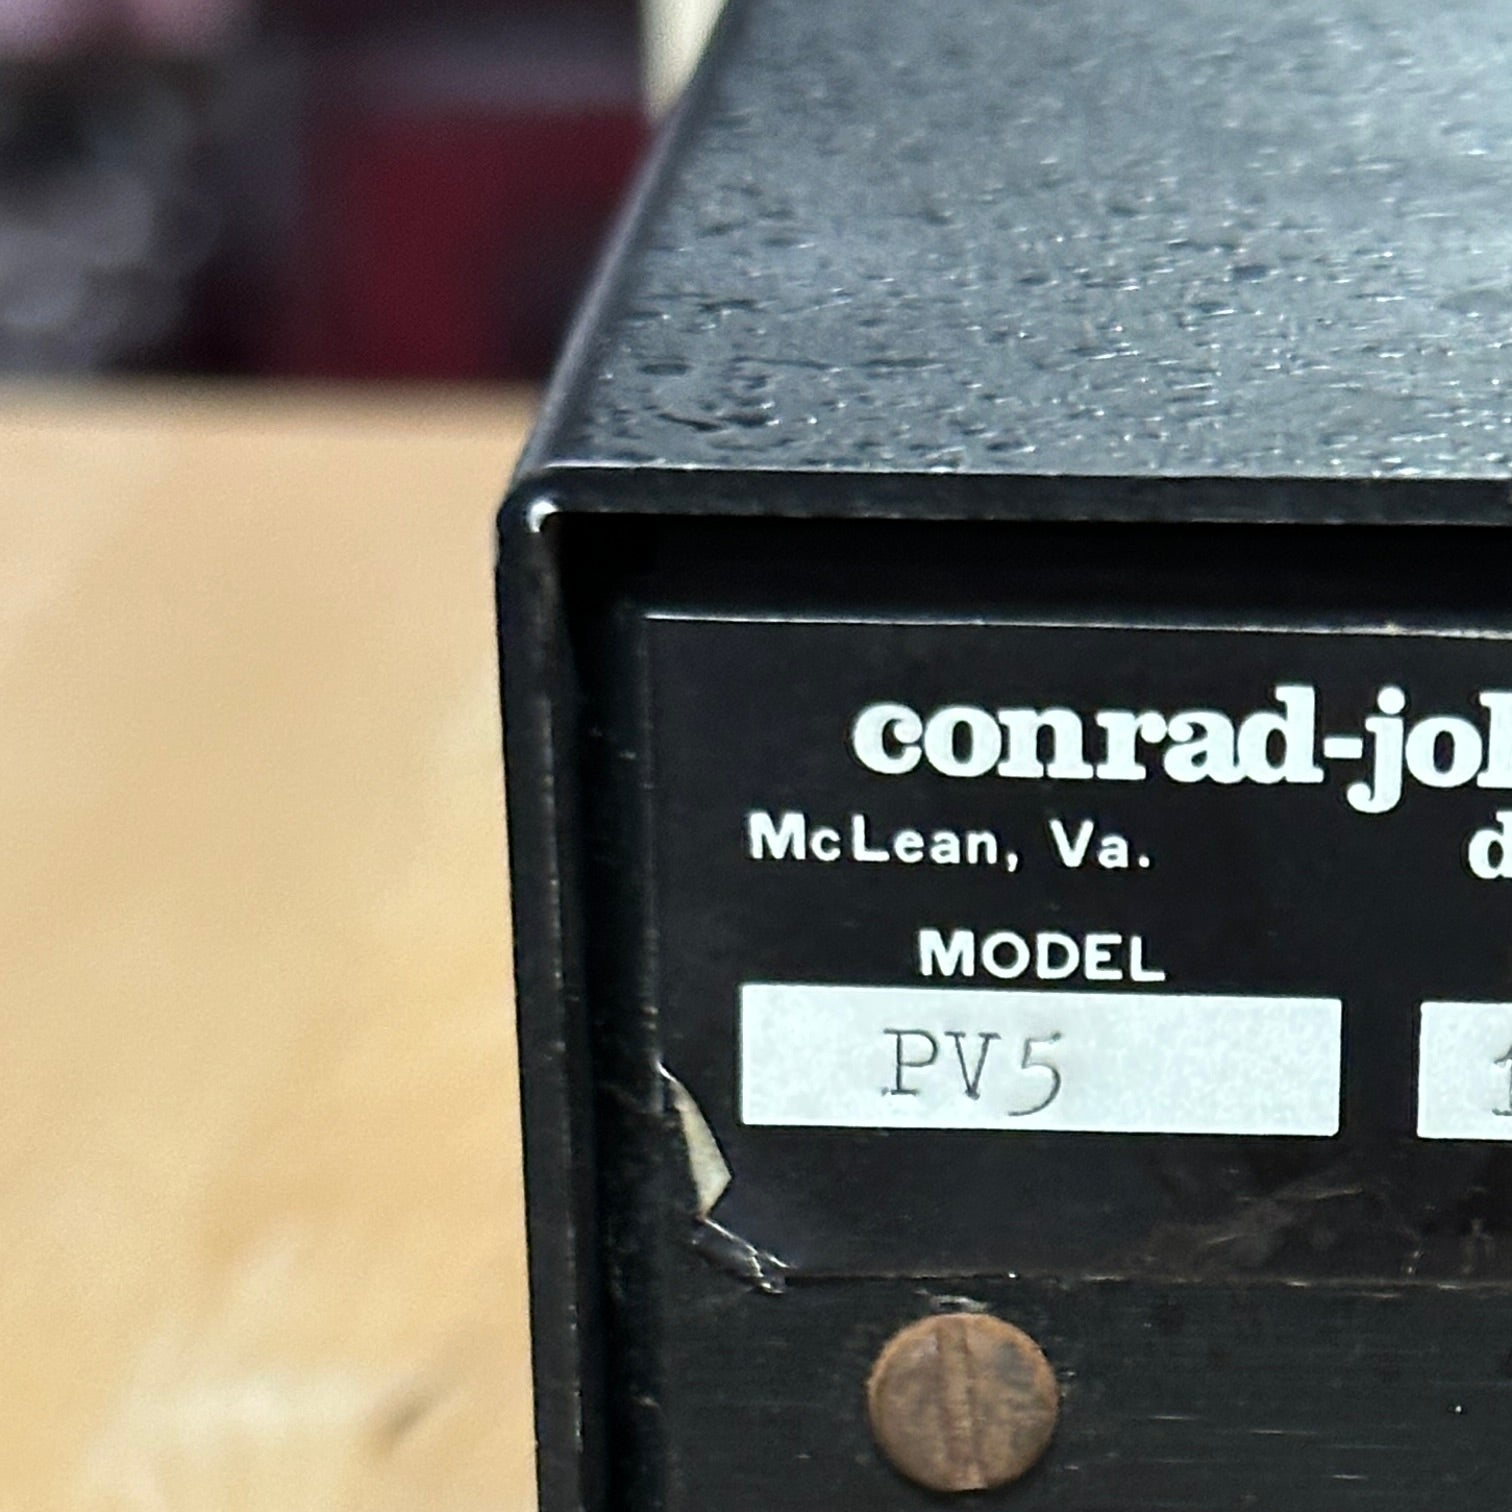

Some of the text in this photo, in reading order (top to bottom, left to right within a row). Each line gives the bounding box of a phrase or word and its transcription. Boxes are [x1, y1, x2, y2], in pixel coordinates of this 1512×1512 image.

[747, 811, 1151, 873] McLean, Va.
[917, 928, 1167, 983] MODEL
[880, 1028, 1064, 1118] PV5
